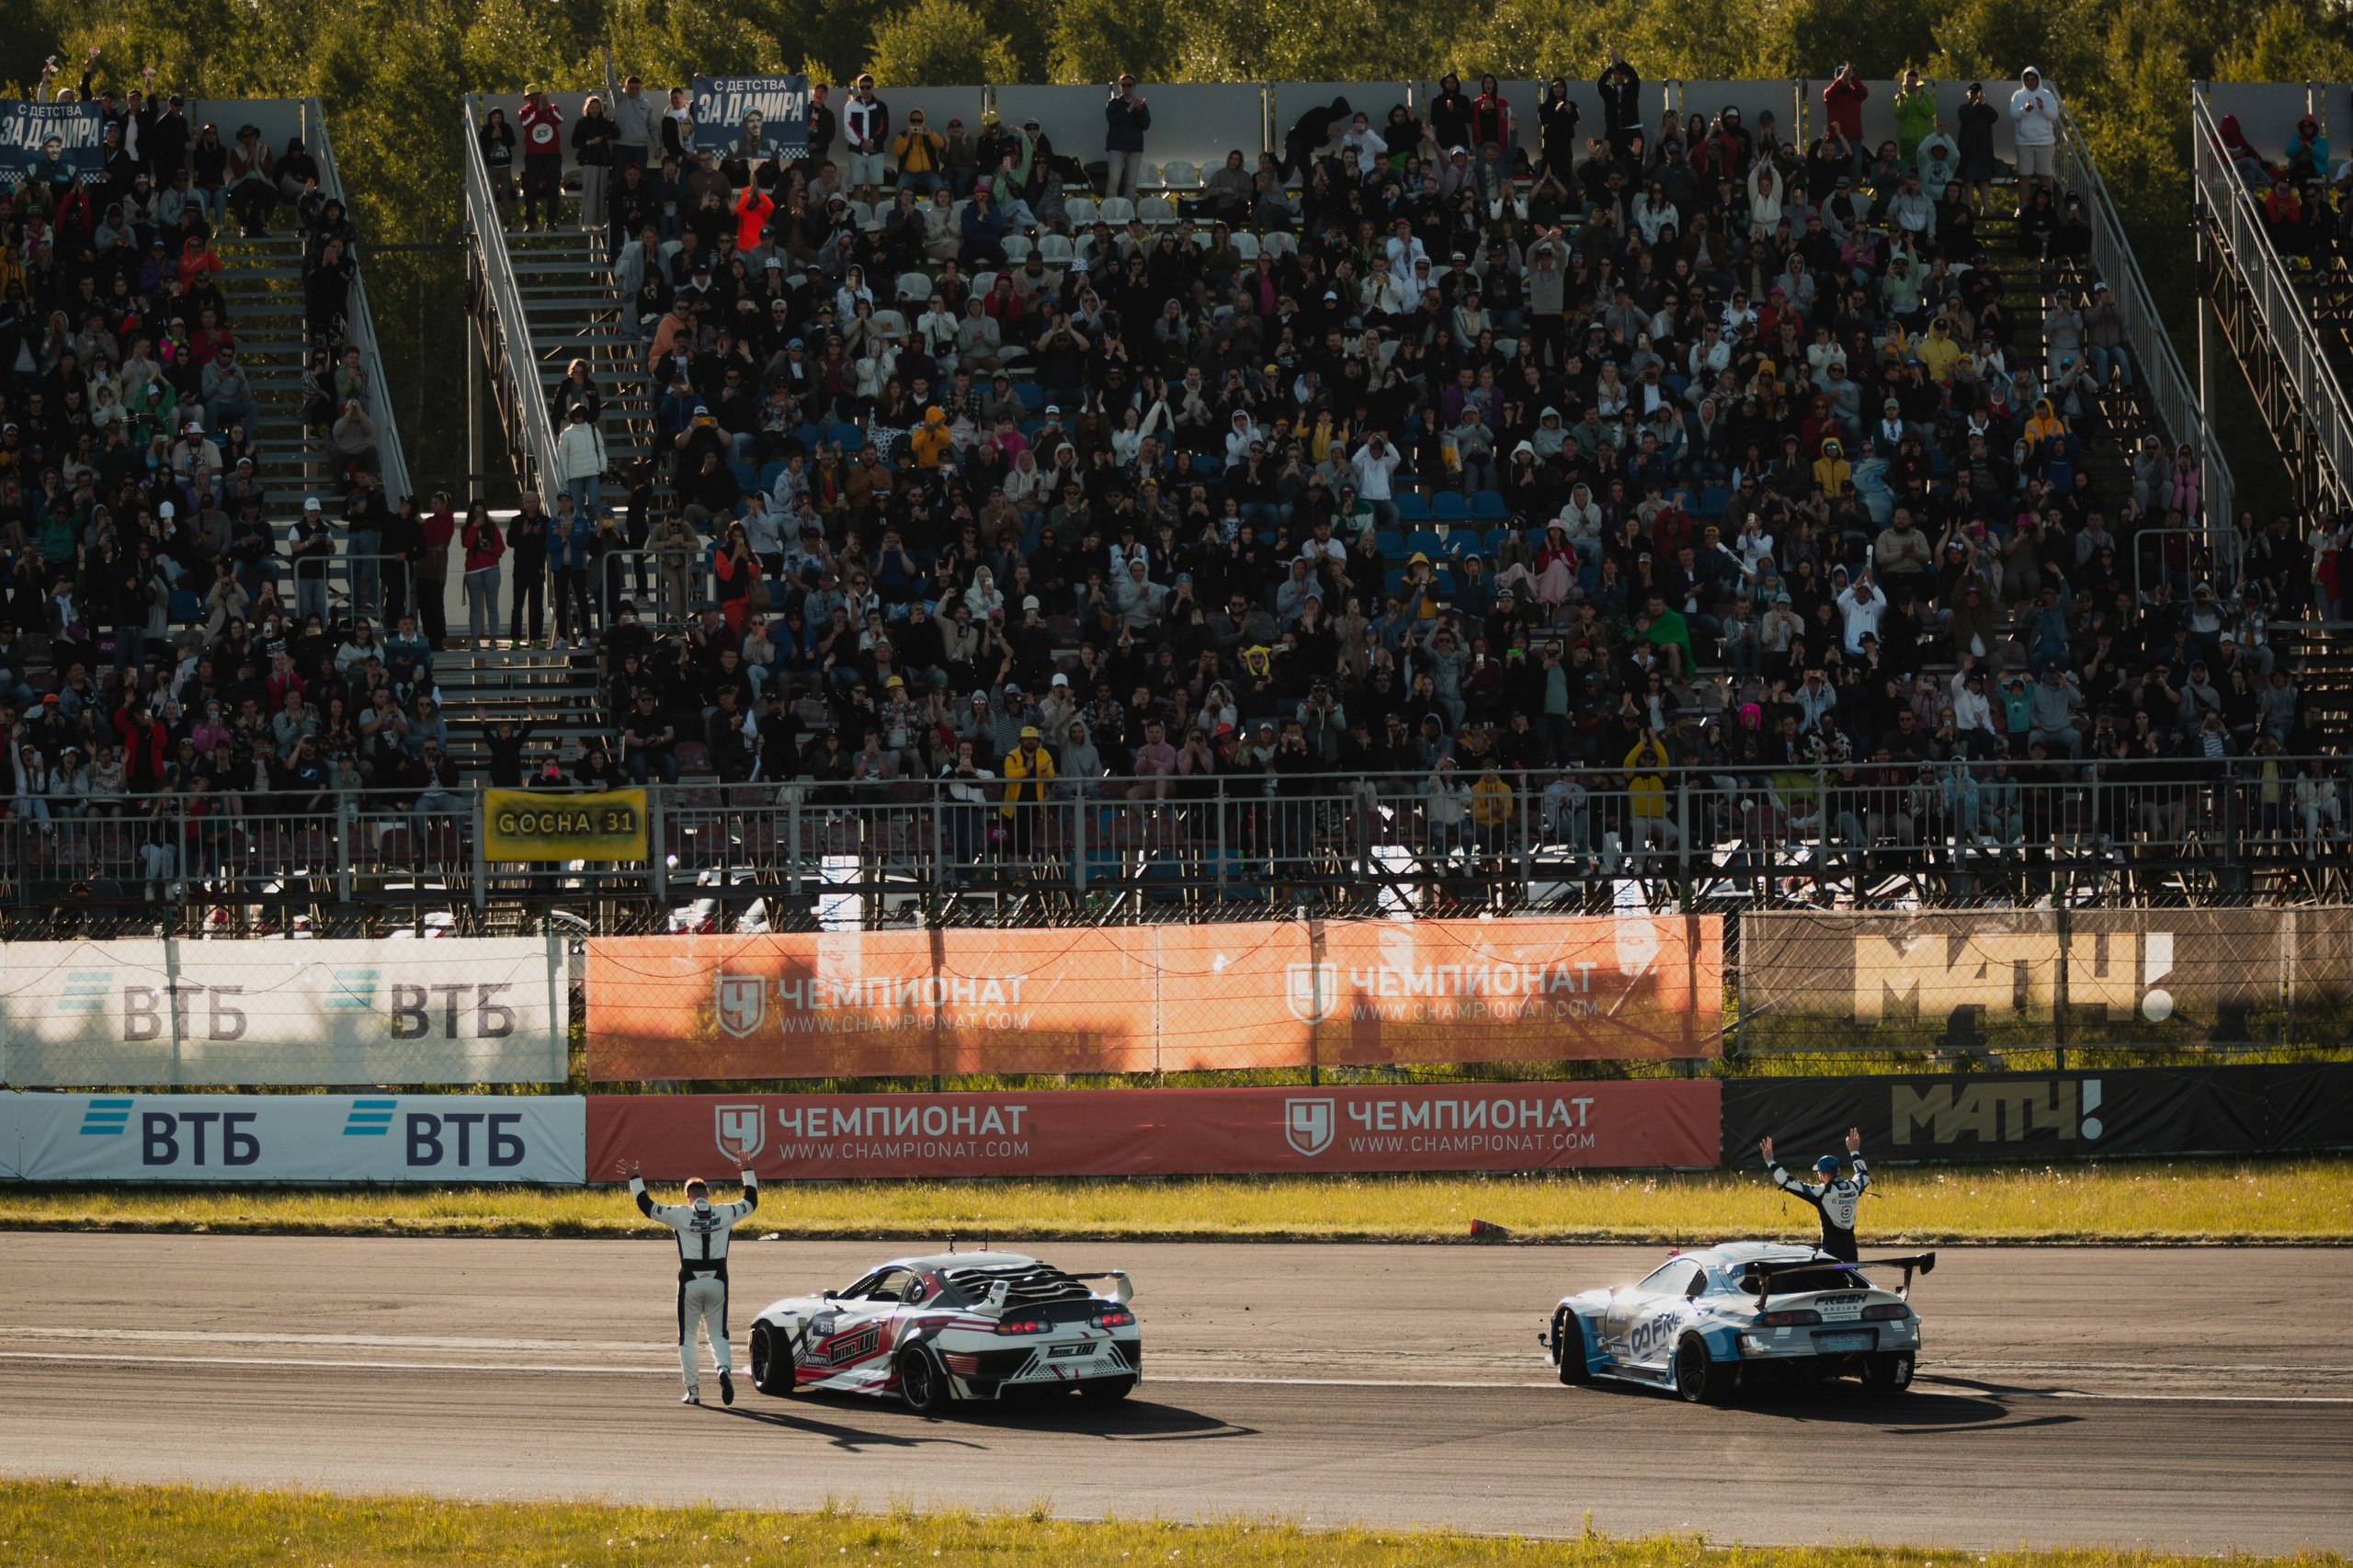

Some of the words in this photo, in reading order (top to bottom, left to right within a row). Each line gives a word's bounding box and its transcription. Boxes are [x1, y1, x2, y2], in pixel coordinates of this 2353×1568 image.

[714, 81, 723, 91] С
[726, 80, 787, 93] ДЕТСТВА
[18, 105, 27, 114] С
[29, 106, 83, 118] ДЕТСТВА
[698, 94, 722, 124] ЗА
[723, 93, 803, 127] ДАМИРА
[0, 116, 24, 146] ЗА
[24, 118, 99, 151] ДАМИРА
[499, 813, 591, 833] GOCHA
[608, 812, 632, 831] 31
[1350, 961, 1597, 997] ЧЕМПИОНАТ
[779, 975, 1029, 1010] ЧЕМПИОНАТ
[124, 985, 247, 1041] ВТБ
[392, 983, 516, 1040] ВТБ
[1350, 1000, 1598, 1020] WWW.CHAMPIONAT.COM
[779, 1014, 1029, 1034] WWW.CHAMPIONAT.COM
[779, 1106, 1028, 1138] ЧЕМПИОНАТ
[1348, 1098, 1595, 1131] ЧЕМПИОНАТ
[142, 1112, 260, 1166] ВТБ
[406, 1113, 526, 1167] ВТБ
[779, 1142, 1029, 1159] WWW.CHAMPIONAT.COM
[1348, 1133, 1596, 1153] WWW.CHAMPIONAT.COM
[1841, 1205, 1852, 1219] 9
[1814, 1294, 1868, 1305] FRESH
[820, 1321, 833, 1333] ВТБ
[827, 1338, 857, 1367] Time
[1047, 1345, 1074, 1358] Time
